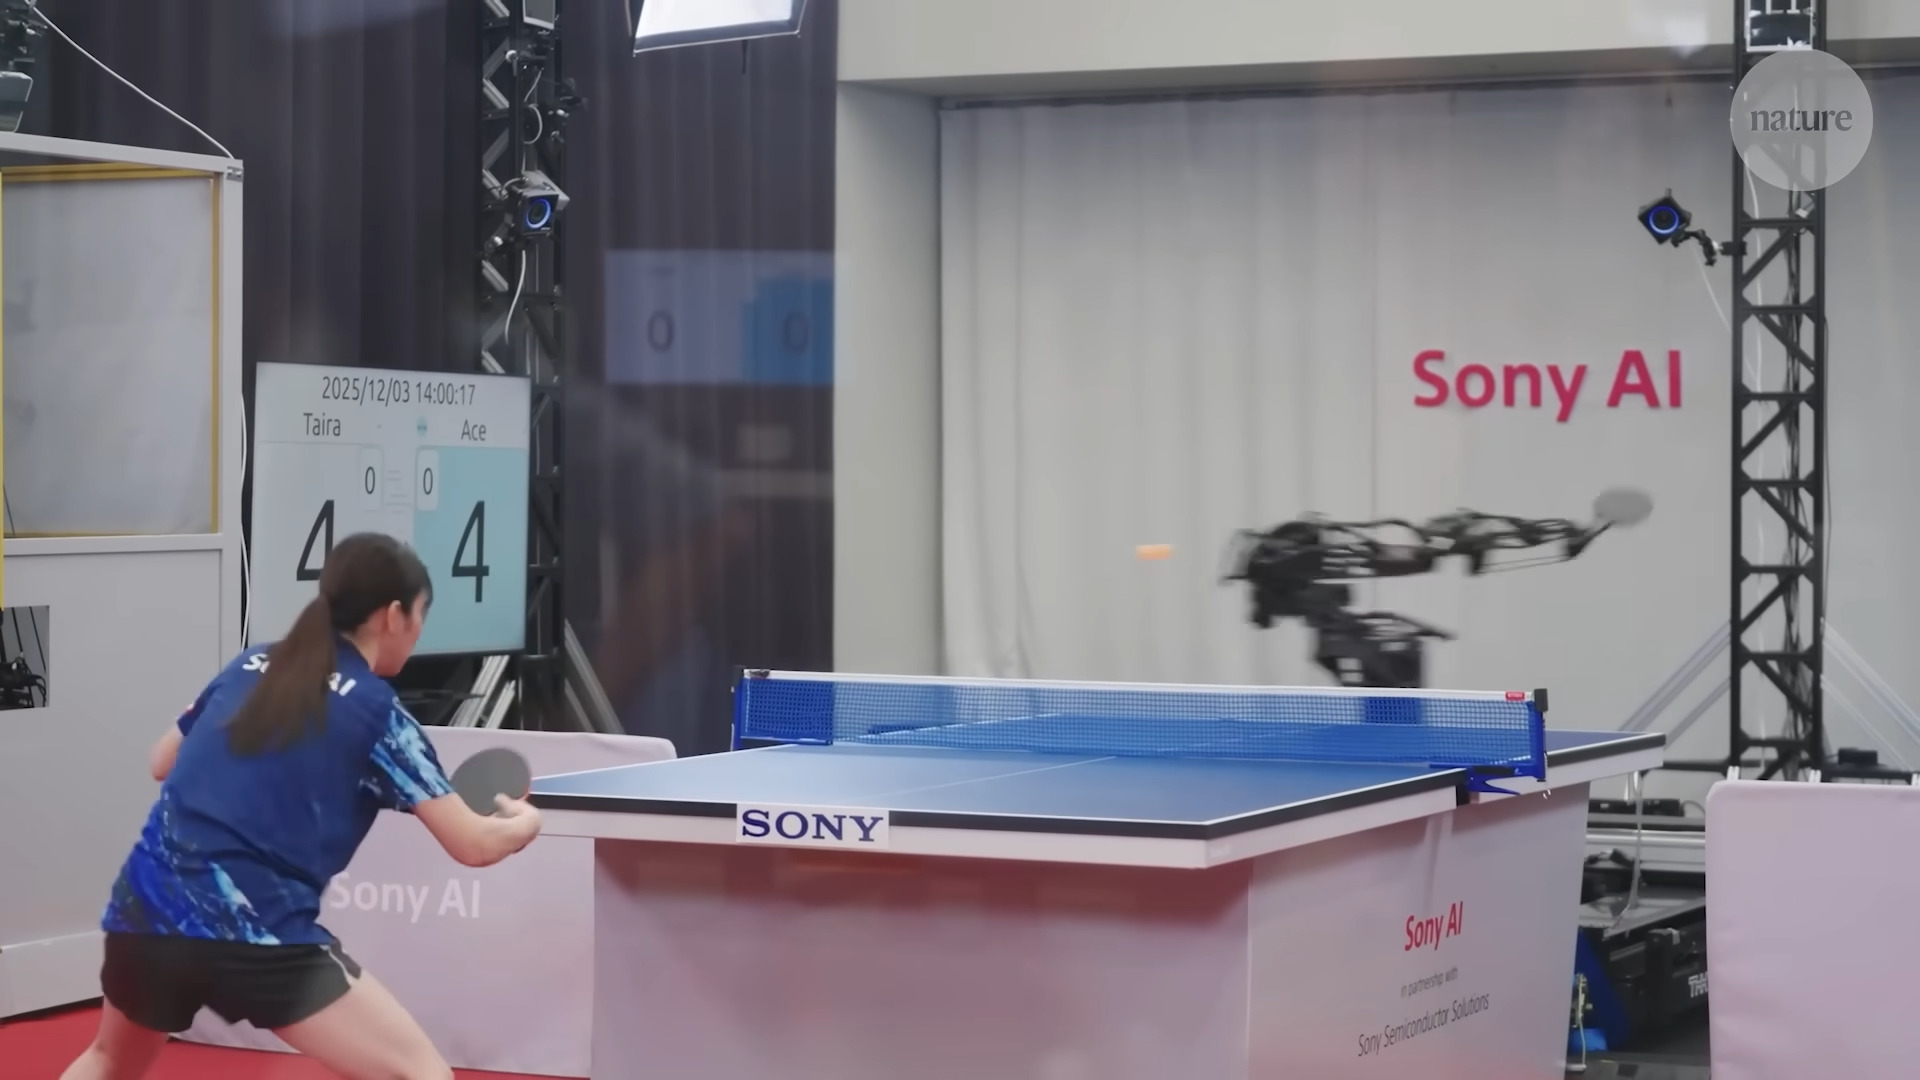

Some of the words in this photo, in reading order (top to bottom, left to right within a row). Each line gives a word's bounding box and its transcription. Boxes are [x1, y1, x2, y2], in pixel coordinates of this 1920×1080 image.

[322, 376, 411, 407] 2025/12/03
[416, 382, 476, 406] 14:00:17
[1412, 349, 1588, 423] Sony
[1606, 349, 1682, 408] AI
[303, 412, 341, 436] Taira
[461, 419, 487, 442] Ace
[365, 466, 376, 495] 0
[423, 467, 434, 495] 0
[296, 499, 335, 581] 4
[452, 500, 490, 603] 4
[742, 809, 884, 842] SONY
[329, 871, 430, 924] Sony
[437, 878, 481, 919] AI
[1404, 915, 1444, 951] Sony
[1446, 901, 1464, 938] AI
[1408, 971, 1444, 997] partnership
[1445, 965, 1459, 982] with
[1358, 1033, 1382, 1057] Sony
[1383, 1007, 1449, 1048] Semiconductor
[1451, 993, 1490, 1022] Solutions
